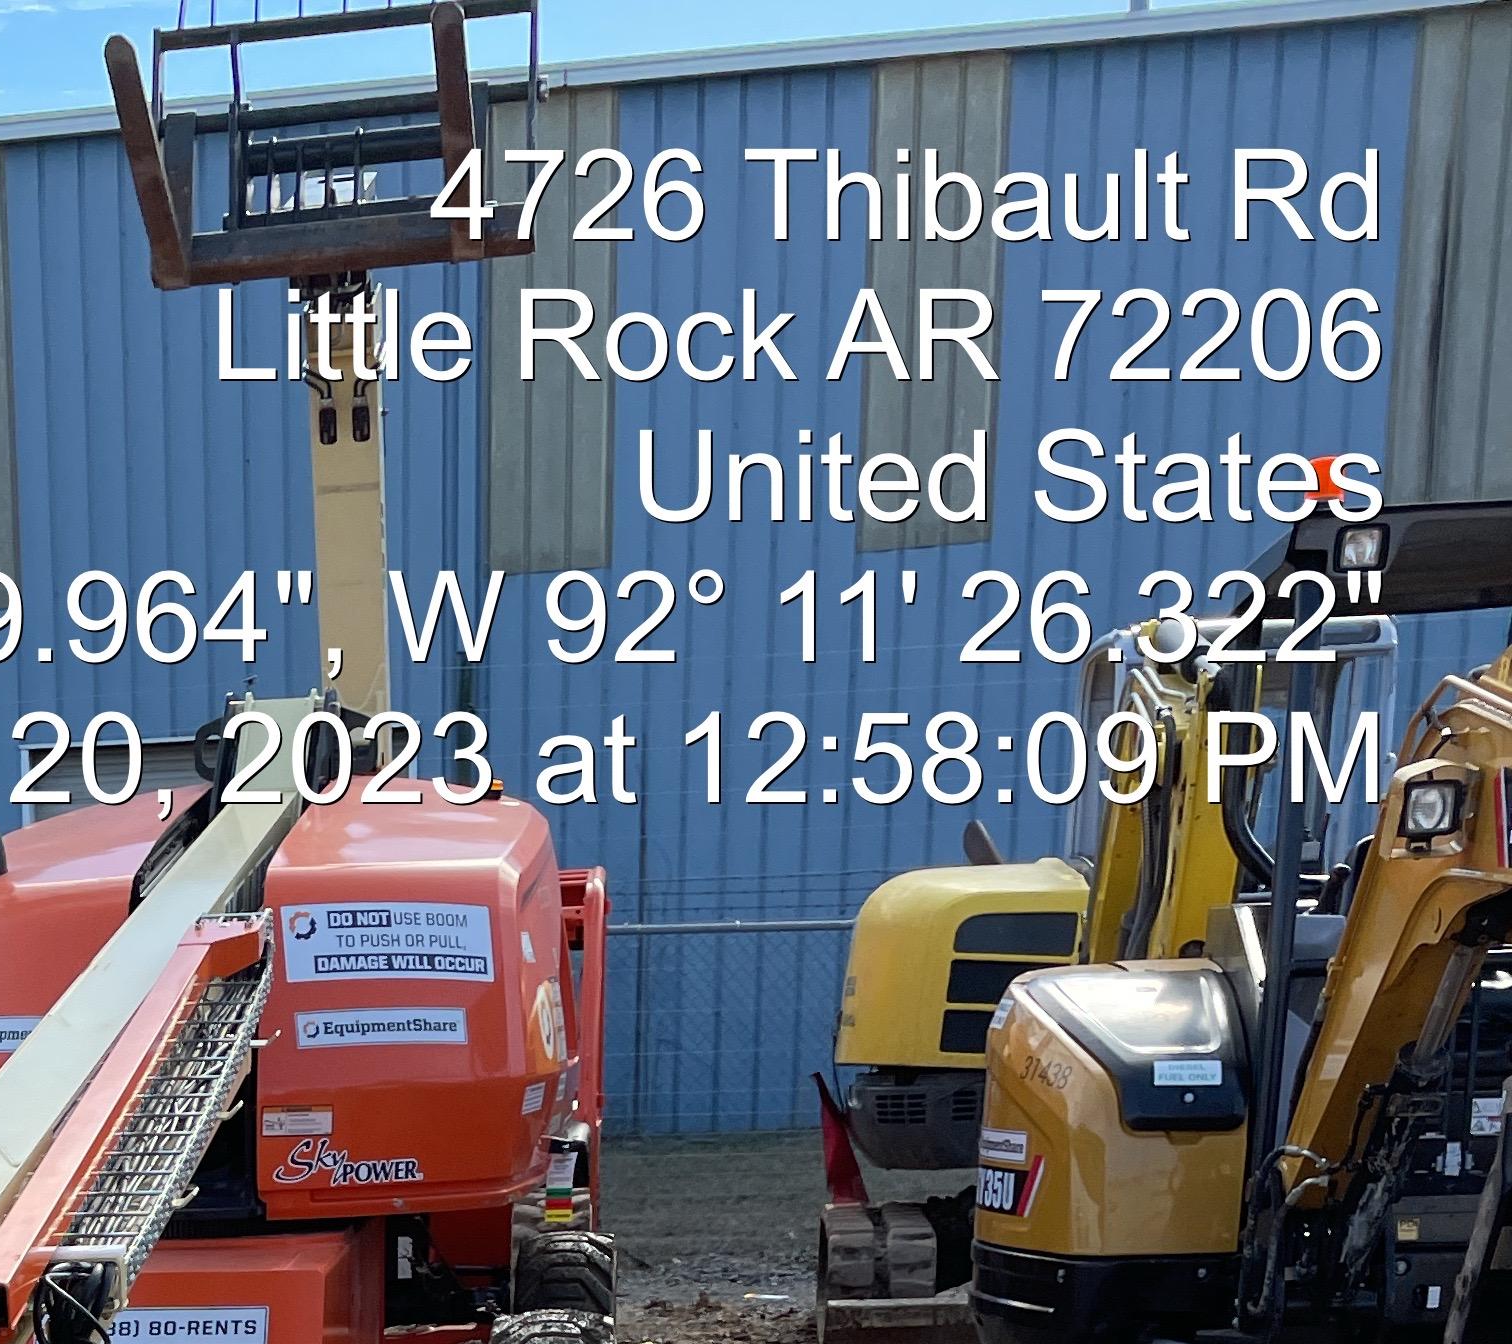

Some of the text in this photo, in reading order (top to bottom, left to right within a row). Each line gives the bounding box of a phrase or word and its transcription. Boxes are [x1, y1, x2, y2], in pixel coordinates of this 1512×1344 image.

[329, 911, 468, 928] DO NOT USE BOOM
[337, 933, 467, 950] TO PUSH OR PULL,
[317, 956, 486, 973] DAMAGE WILL OCCUR
[323, 1018, 458, 1037] EquipmentShare
[1158, 1072, 1217, 1081] FUEL ONLY
[148, 1319, 257, 1337] 80-RENTS
